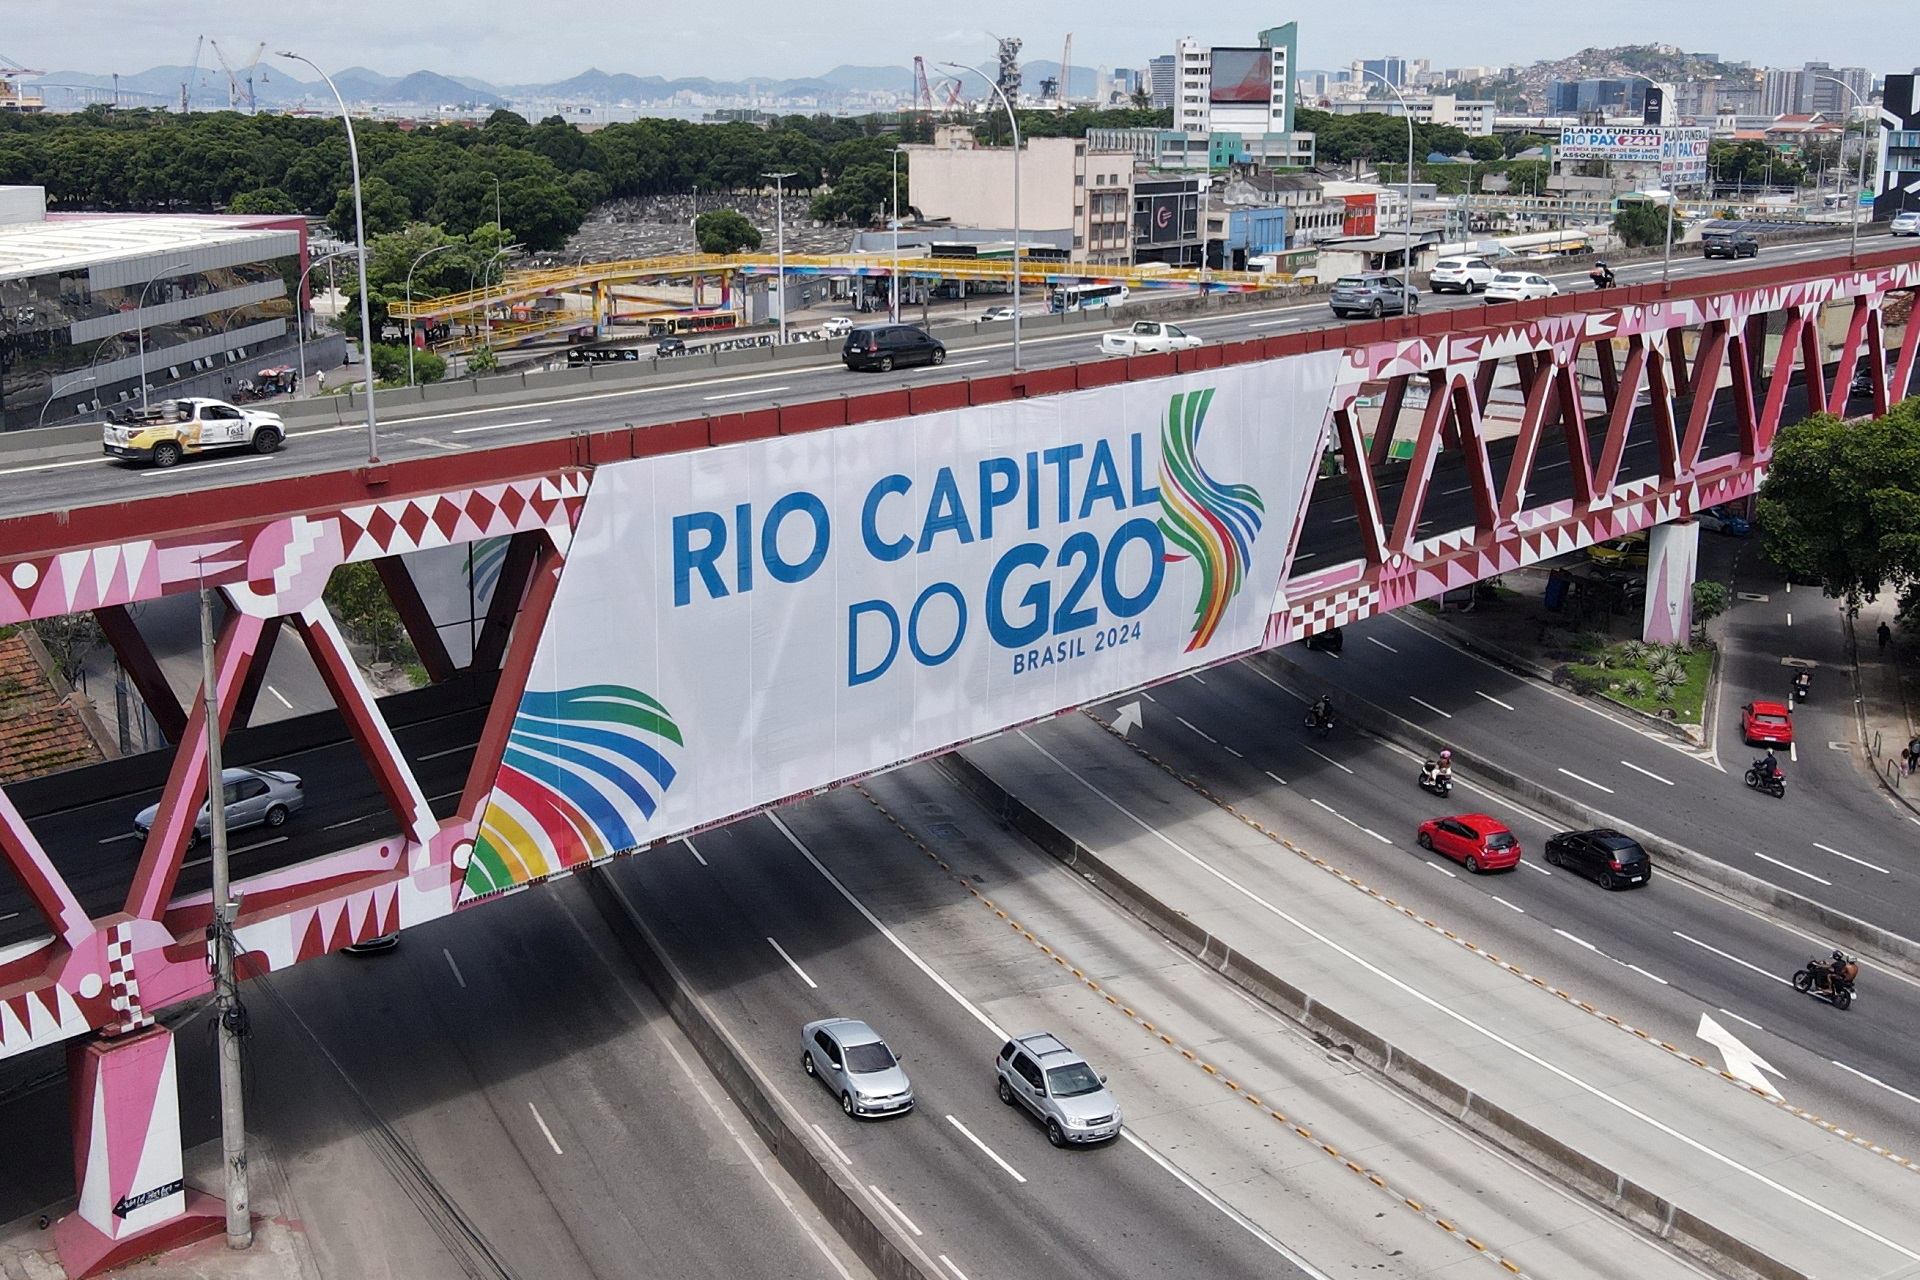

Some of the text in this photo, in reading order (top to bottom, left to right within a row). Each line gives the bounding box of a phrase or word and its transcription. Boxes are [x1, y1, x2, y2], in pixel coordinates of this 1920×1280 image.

[1563, 135, 1658, 146] RIO PAX 24H
[672, 432, 1161, 607] RIO CAPITAL
[848, 517, 1167, 687] DO G20
[1013, 620, 1142, 675] BRASIL 2024
